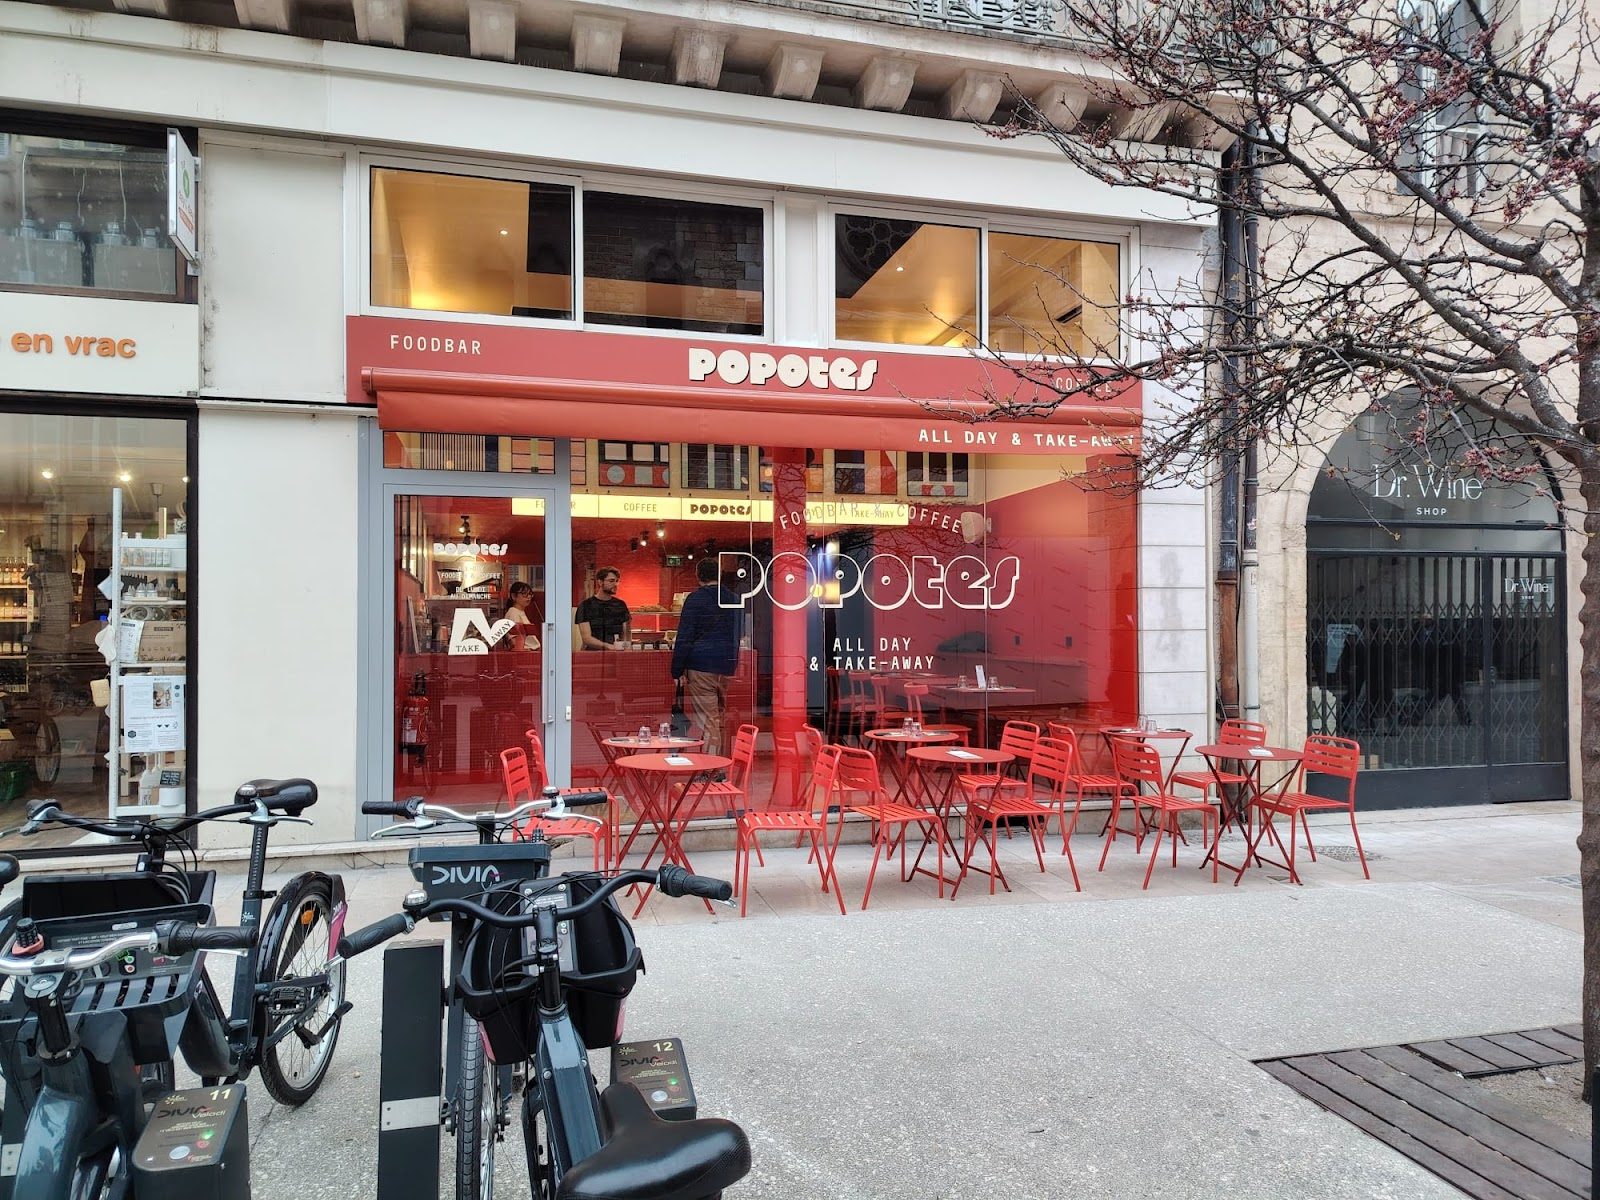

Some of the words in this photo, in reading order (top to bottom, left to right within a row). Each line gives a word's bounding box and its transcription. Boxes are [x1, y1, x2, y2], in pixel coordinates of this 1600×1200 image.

[11, 332, 53, 354] en
[64, 335, 137, 359] vrac
[390, 334, 481, 355] FOODBAR
[1056, 377, 1112, 393] COFEE
[918, 428, 953, 444] ALL
[964, 430, 998, 446] DAY
[1011, 432, 1022, 446] &
[1371, 463, 1411, 499] Dr.
[623, 502, 658, 513] COFFEE
[1416, 507, 1447, 516] SHOP
[896, 503, 962, 534] COFFEE
[491, 620, 514, 643] AWAY
[455, 644, 480, 653] TAKE
[832, 637, 865, 652] ALL
[879, 637, 912, 652] DAY
[809, 656, 819, 672] &
[832, 655, 935, 672] TAKE-AWAY
[653, 1041, 675, 1053] 12
[209, 1088, 232, 1101] 11
